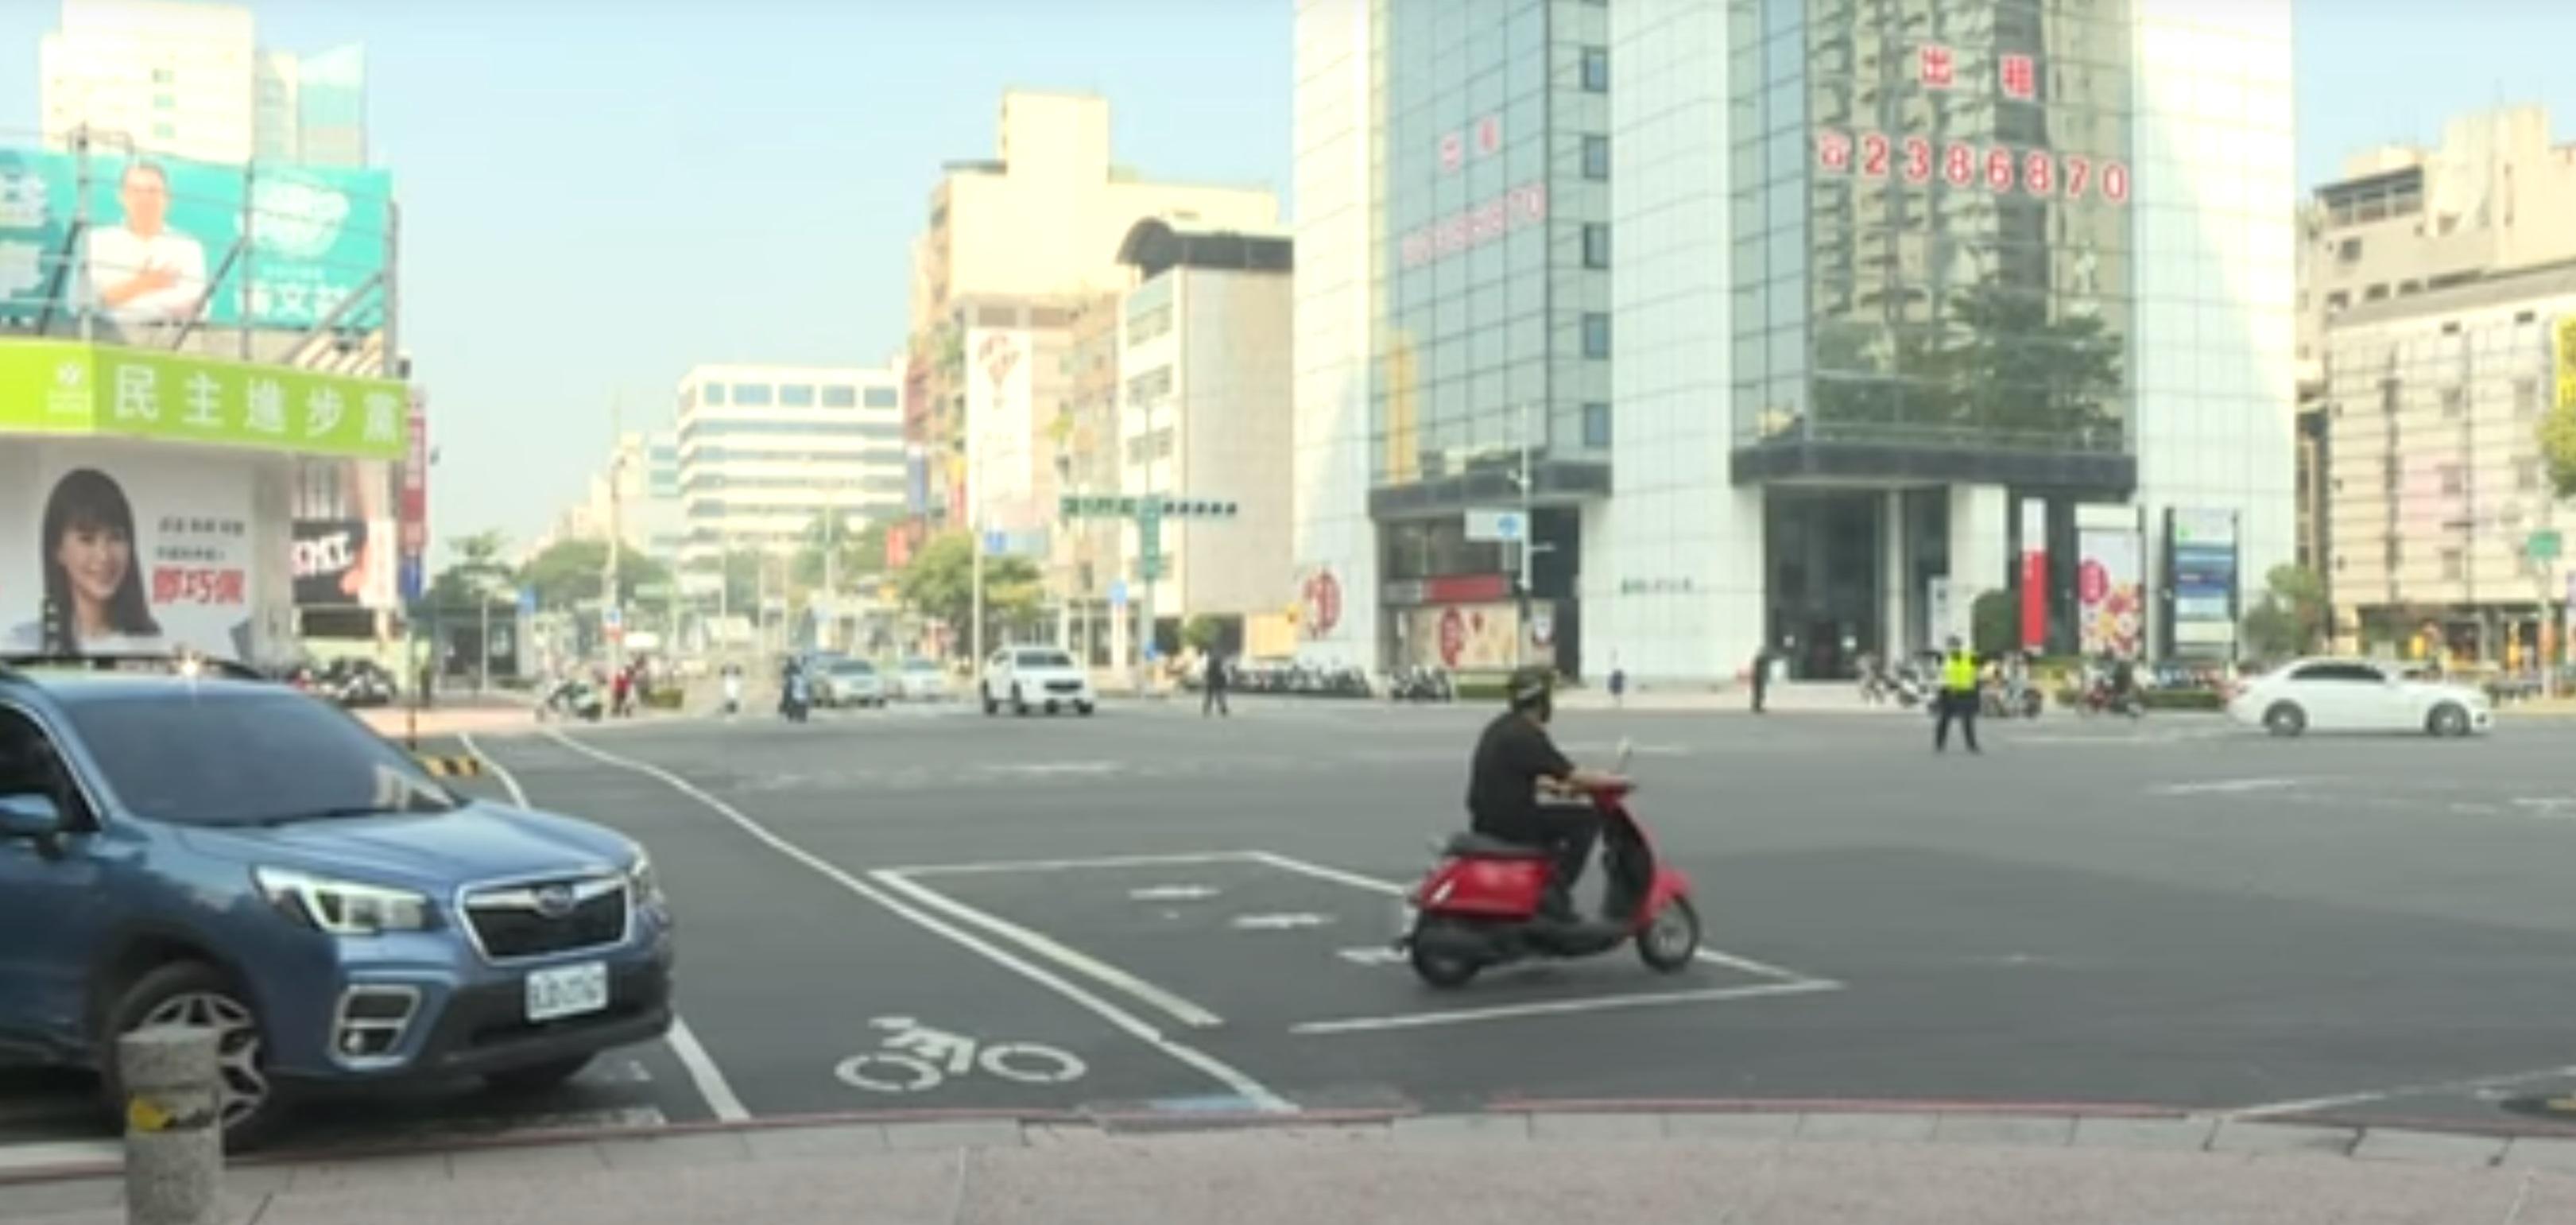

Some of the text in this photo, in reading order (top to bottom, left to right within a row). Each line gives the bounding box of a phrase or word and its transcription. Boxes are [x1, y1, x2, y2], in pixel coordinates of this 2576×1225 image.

[1919, 45, 2034, 99] 出租
[1864, 134, 2128, 204] 2386870
[115, 364, 398, 441] 民主進步黨
